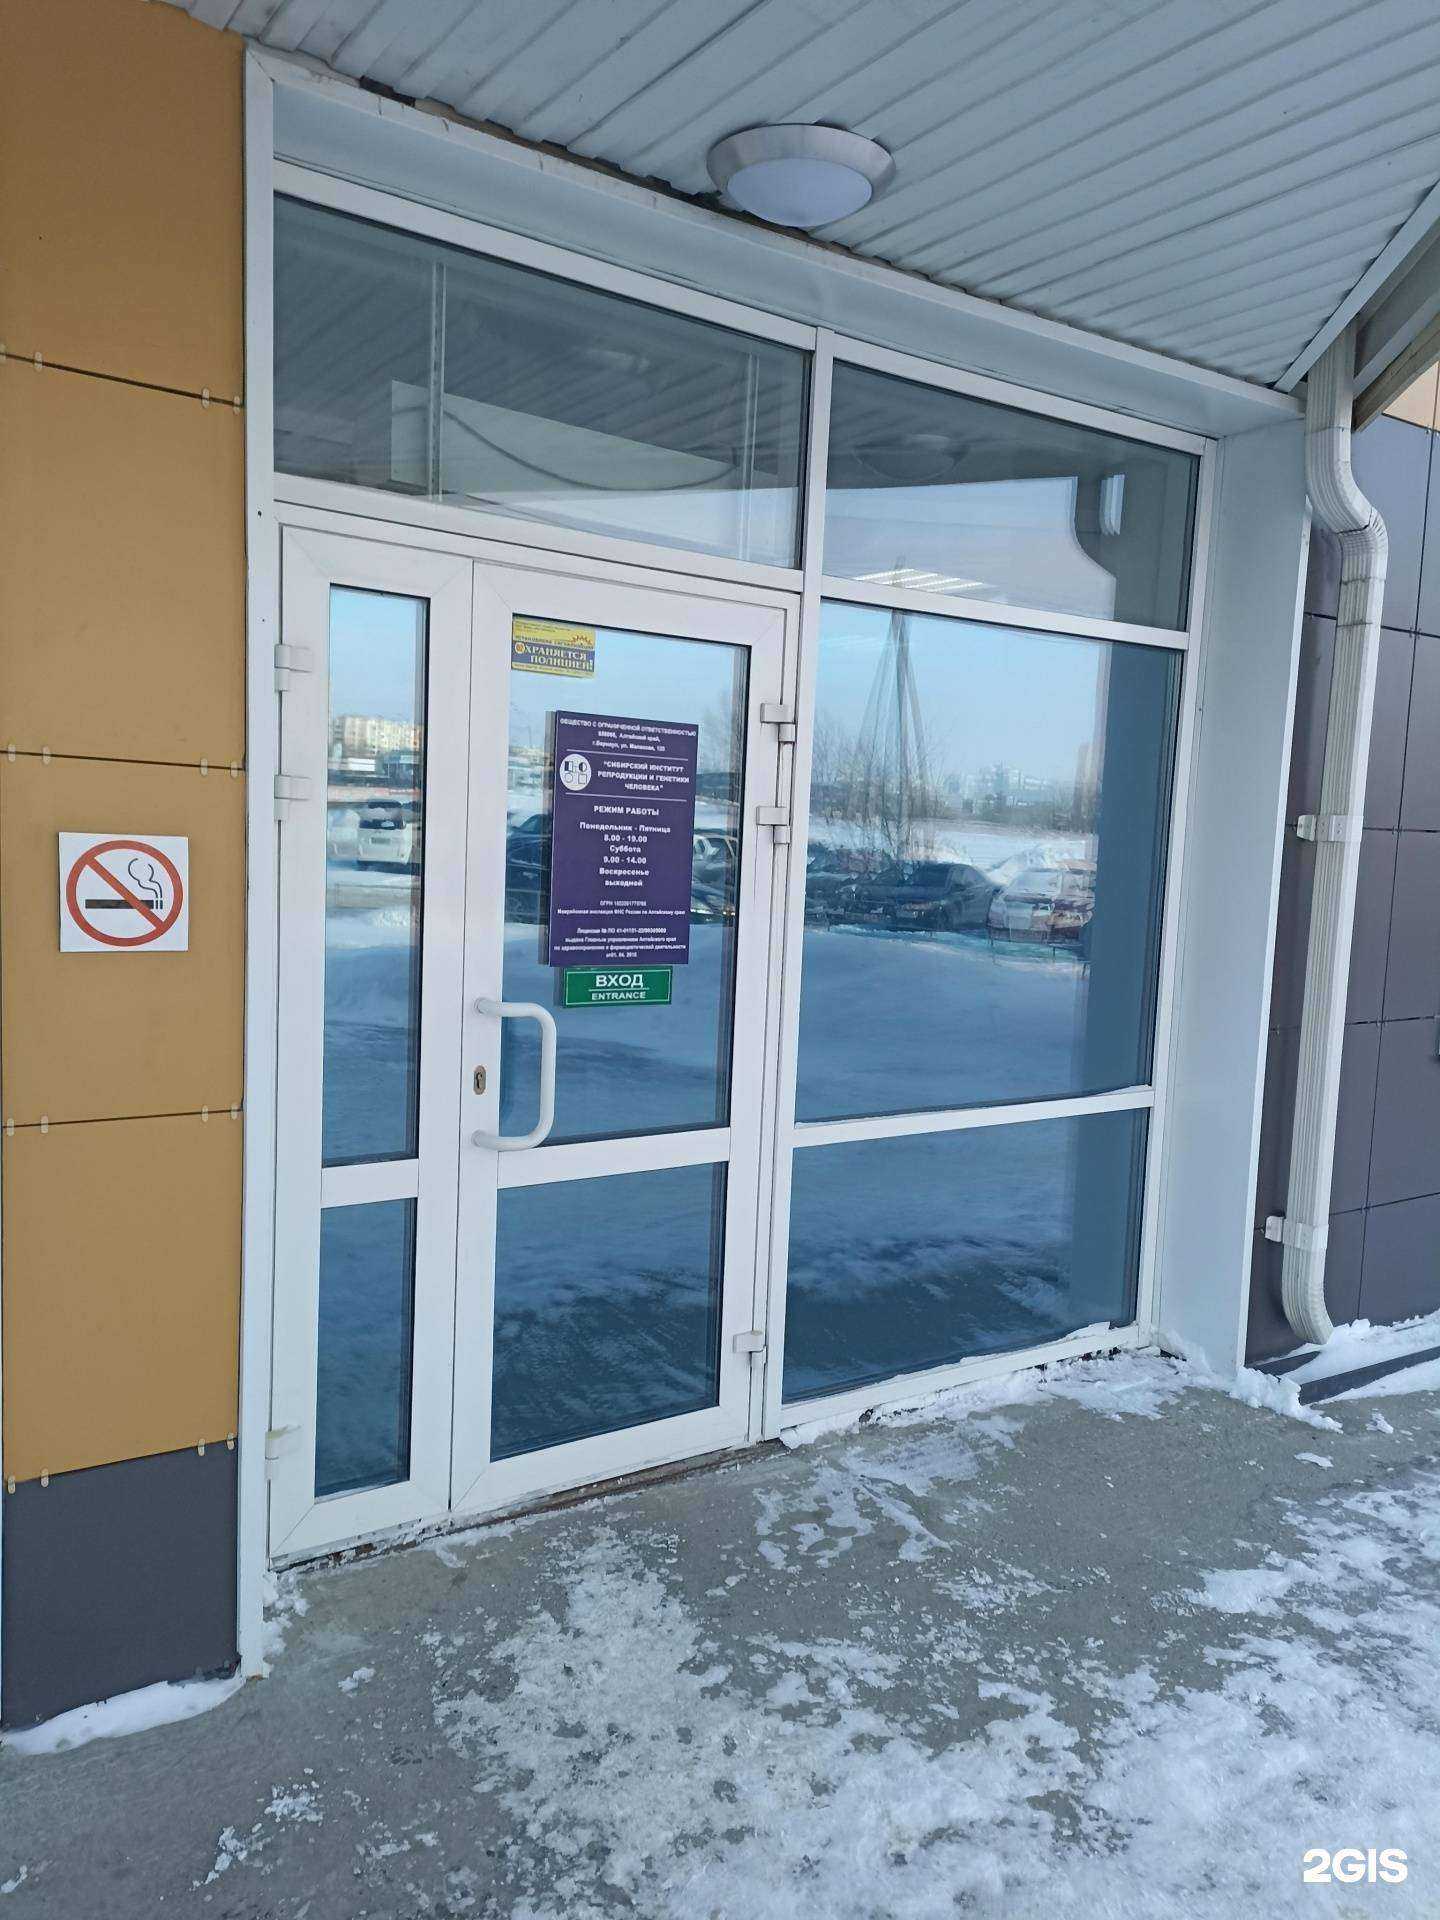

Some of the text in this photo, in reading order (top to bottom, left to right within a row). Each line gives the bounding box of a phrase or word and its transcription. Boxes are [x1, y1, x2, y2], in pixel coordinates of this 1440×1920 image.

[560, 718, 592, 727] ОБЩЕСТВО
[597, 721, 640, 731] ОГРАНИЧЕННОЙ
[641, 726, 697, 737] ОТВЕТСТВЕННОСТЬЮ
[603, 760, 685, 773] "СИБИРСКИЙ ИНСТИТУТ
[598, 770, 648, 781] РЕПРОДУКЦИИ
[656, 775, 690, 784] ГЕНЕТИКИ
[624, 783, 664, 792] ЧЕЛОВЕКА"
[593, 805, 660, 816] РЕЖИМ РАБОТЫ
[579, 821, 633, 832] Понедельник
[639, 824, 671, 834] Пятница
[603, 834, 621, 842] 8.00
[627, 835, 648, 843] 19.00
[609, 844, 642, 853] Суббота
[603, 855, 620, 864] 9.00
[626, 856, 647, 864] 14.00
[599, 867, 650, 876] Воскресенье
[604, 879, 643, 888] выходной
[595, 974, 644, 989] ВХОД
[591, 991, 647, 1001] ENTRANCE
